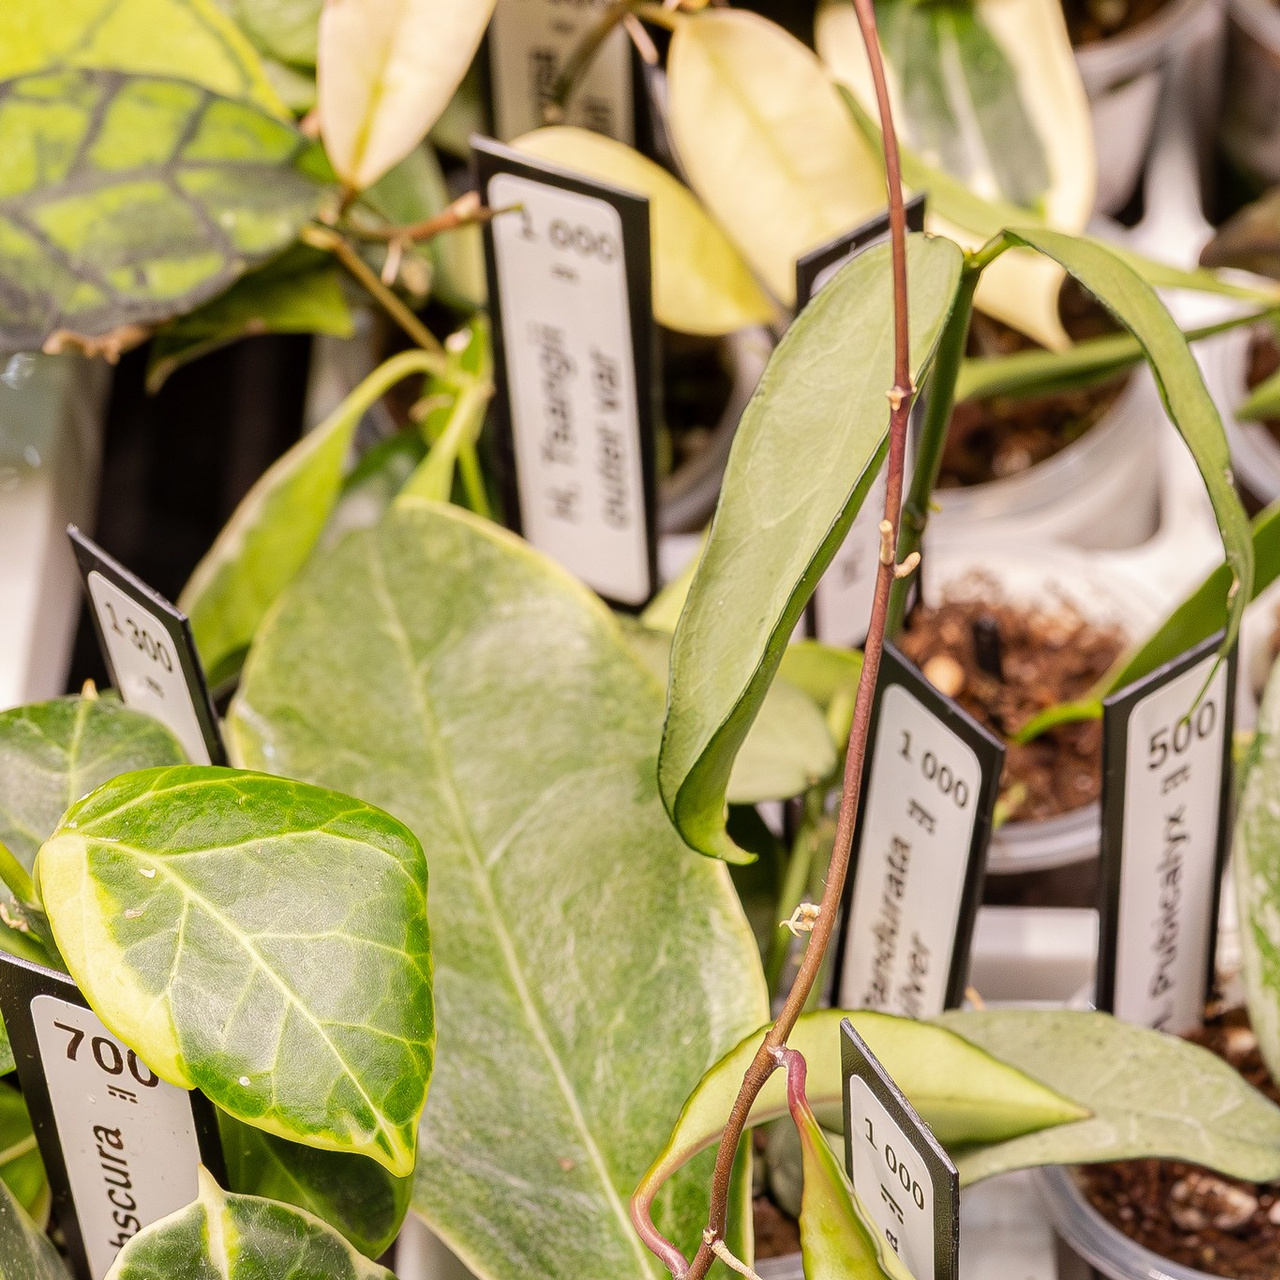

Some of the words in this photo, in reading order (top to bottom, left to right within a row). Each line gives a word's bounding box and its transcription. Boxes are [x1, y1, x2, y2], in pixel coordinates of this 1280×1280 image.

[548, 218, 618, 263] 000
[105, 602, 124, 638] 1
[898, 728, 913, 763] 1
[922, 751, 970, 808] 000
[1148, 700, 1216, 770] 500
[864, 1117, 878, 1151] 1
[885, 1144, 925, 1211] 000
